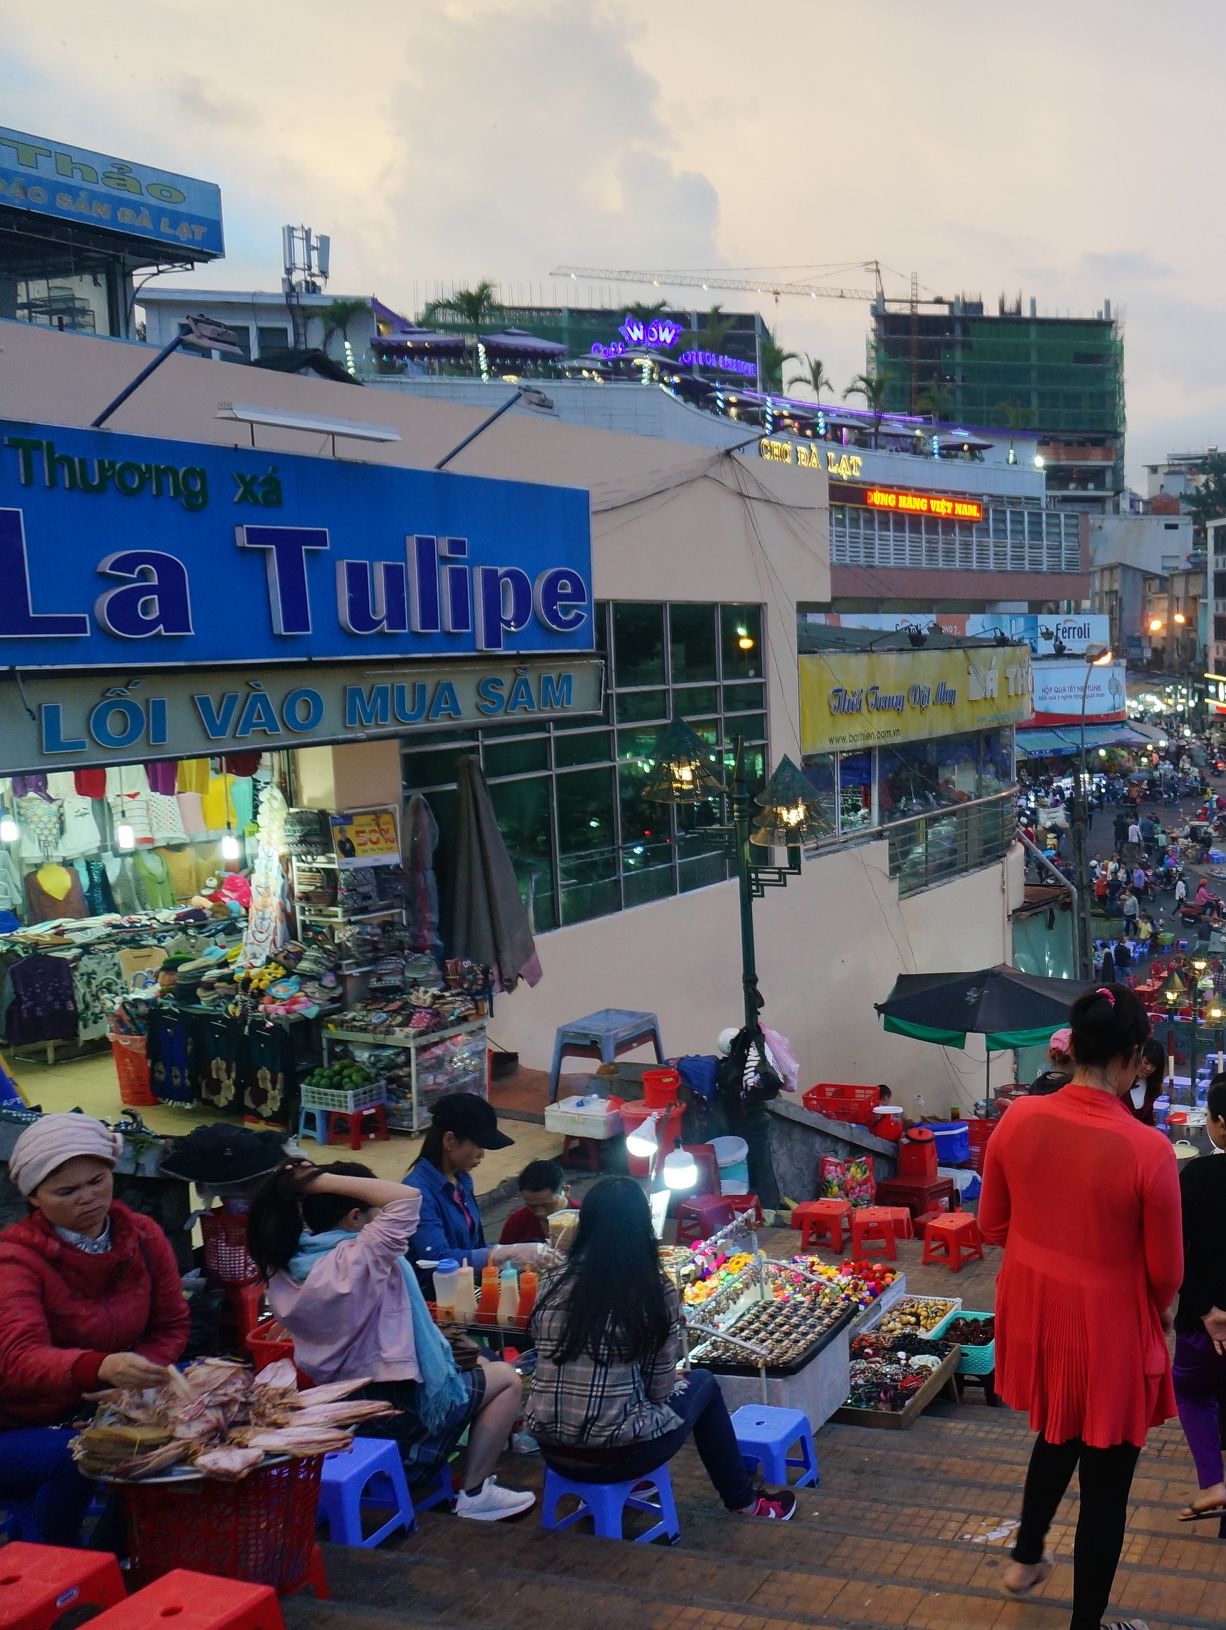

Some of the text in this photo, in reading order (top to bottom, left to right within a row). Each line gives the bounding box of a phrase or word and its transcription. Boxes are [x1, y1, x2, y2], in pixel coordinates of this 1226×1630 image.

[160, 217, 208, 241] LẠT
[5, 436, 284, 510] Thương xá
[797, 443, 822, 470] ĐÀ
[827, 451, 863, 480] LẠT
[898, 494, 928, 511] HÀNG
[930, 498, 953, 515] VIỆT
[955, 502, 980, 517] NAM.
[0, 507, 589, 652] La Tulipe
[1055, 622, 1090, 642] Ferroli
[1077, 684, 1102, 692] NETUNE
[40, 680, 168, 755] LỐI
[194, 681, 325, 741] VÀO
[346, 680, 463, 728] MUA
